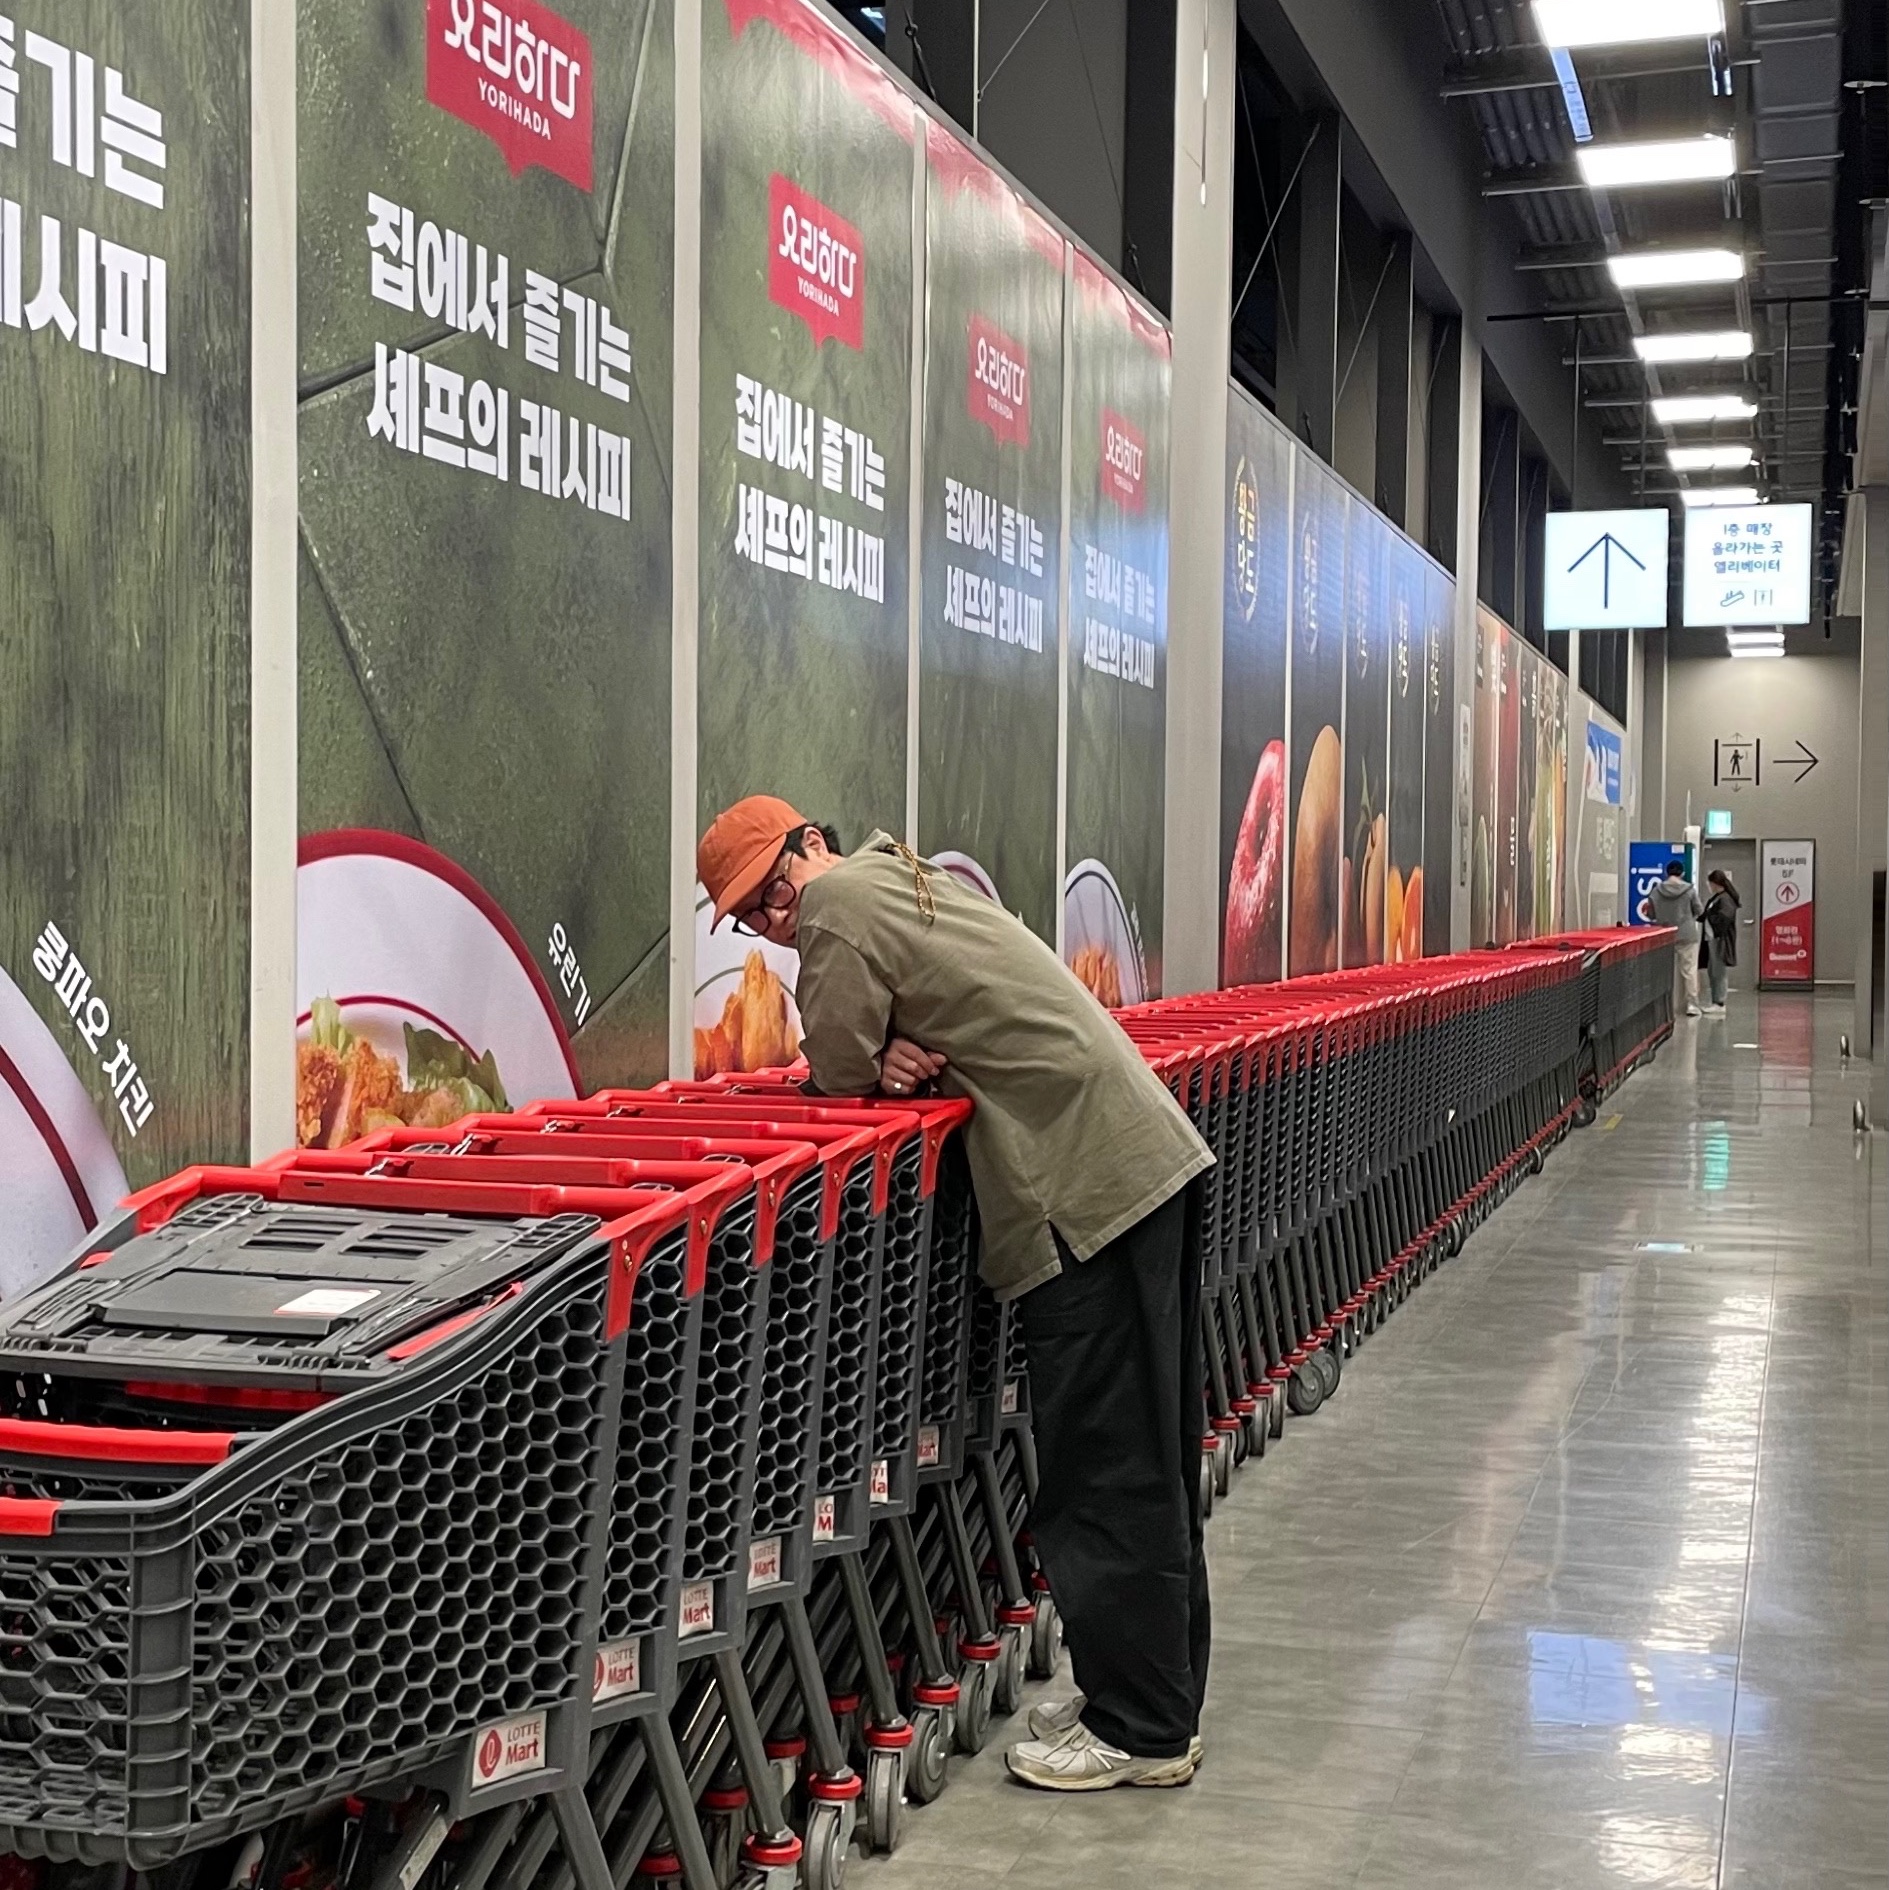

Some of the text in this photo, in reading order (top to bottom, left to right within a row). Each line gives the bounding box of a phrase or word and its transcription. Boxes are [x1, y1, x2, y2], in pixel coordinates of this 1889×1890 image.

[444, 0, 581, 119] 요리하다
[0, 15, 166, 210] 기는
[478, 77, 551, 140] YORIHADA
[779, 204, 857, 298] 요리하다
[366, 192, 631, 402] 집에서 즐기는
[798, 275, 839, 317] YORIHADA
[975, 337, 1025, 406] 요리하다
[366, 341, 631, 521] 셰프의 레시피
[735, 373, 885, 511] 집에서 즐기는
[734, 483, 884, 603] 셰프의 레시피
[945, 476, 1043, 578] 집에서 즐기는
[1712, 540, 1784, 556] 올라가는 곳
[1746, 522, 1773, 536] 매장
[1085, 544, 1155, 624] 집에서 즐기는
[1714, 558, 1781, 574] 엘리베이터
[944, 565, 1043, 653] 셰프의 레시피
[1084, 617, 1155, 689] 셰프의 레시피
[548, 922, 592, 1026] 유린기
[32, 921, 155, 1136] 쿵파오 치킨
[753, 1556, 776, 1578] Mart
[682, 1603, 711, 1626] Mart
[607, 1663, 634, 1687] Mart
[608, 1646, 635, 1667] LOTTE
[505, 1738, 538, 1766] Mart
[507, 1721, 540, 1742] LOTTE
